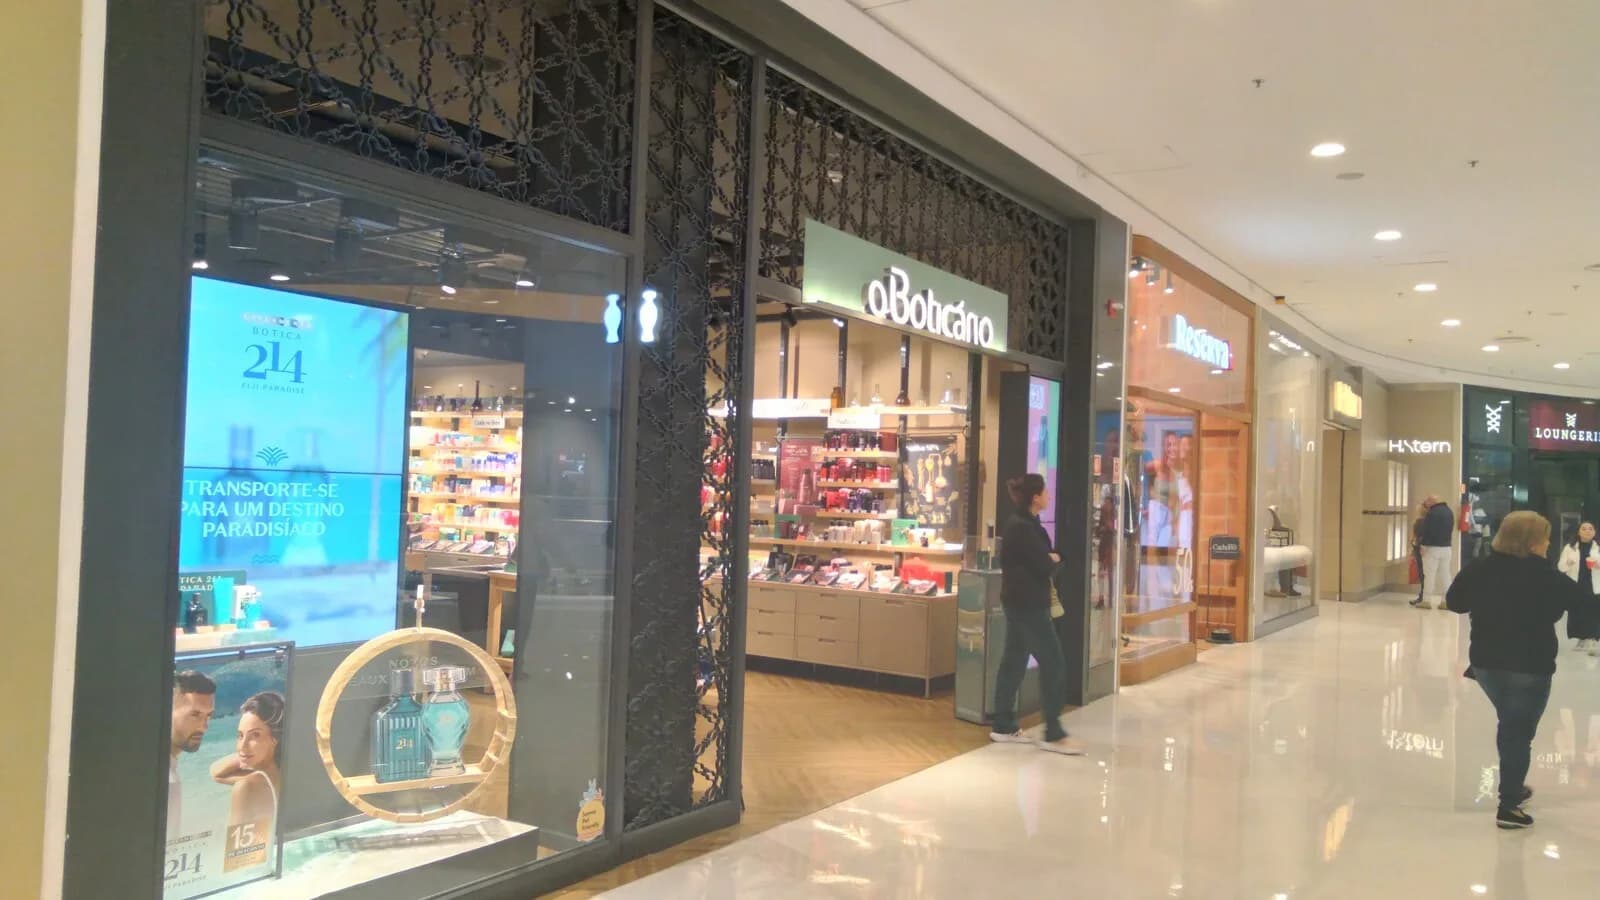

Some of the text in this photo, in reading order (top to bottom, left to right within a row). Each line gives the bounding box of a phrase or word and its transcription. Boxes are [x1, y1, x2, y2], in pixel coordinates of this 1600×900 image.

[252, 326, 302, 340] BOTICA
[242, 340, 308, 384] 214
[262, 384, 305, 395] PARADISE
[1535, 427, 1600, 442] LOUNGERI
[185, 480, 339, 498] TRANSPORTE-SE
[234, 501, 264, 517] UM
[268, 502, 344, 517] DESTINO
[203, 518, 326, 538] PARADISÍACO
